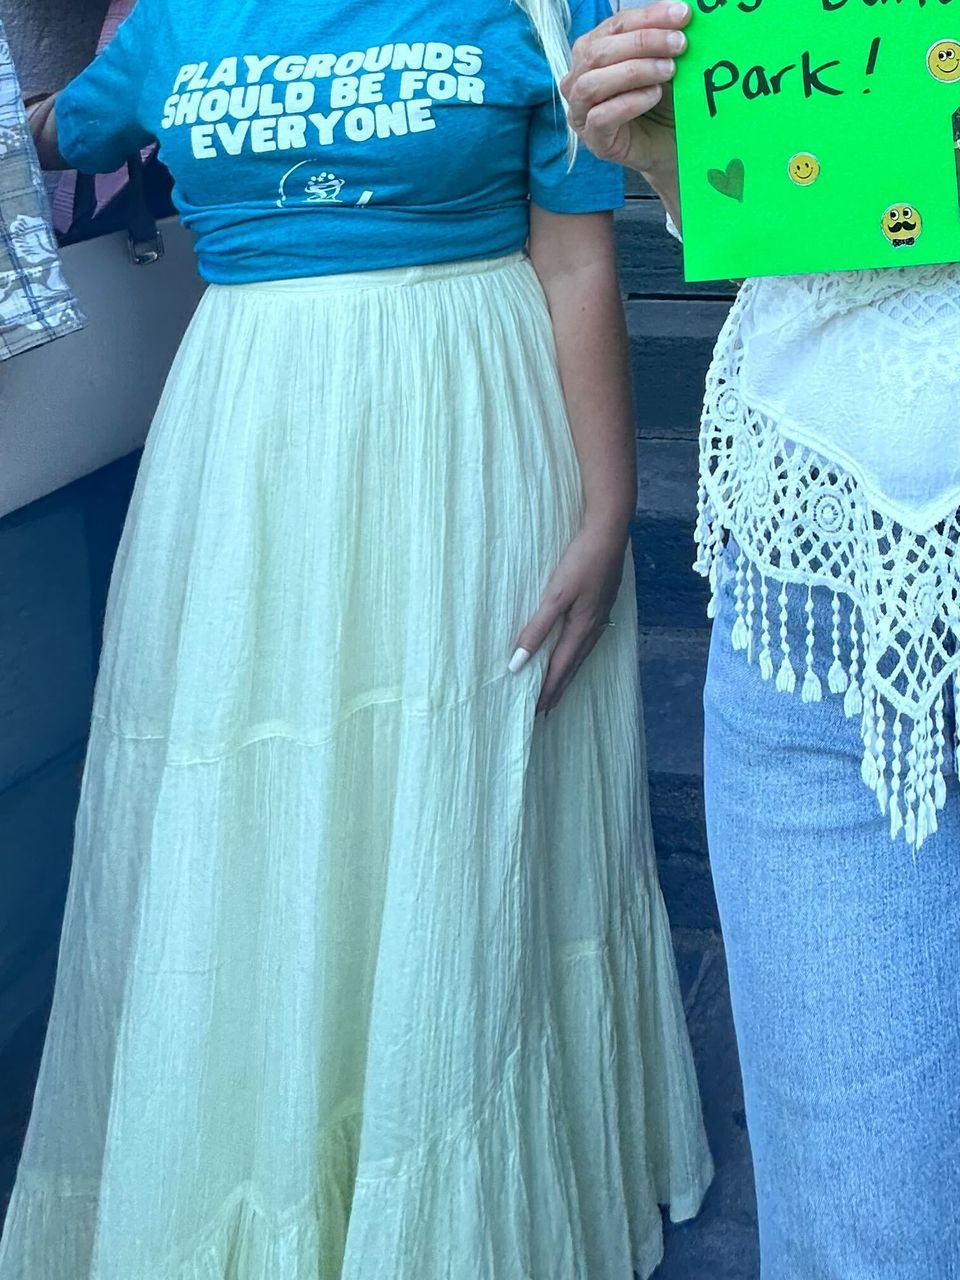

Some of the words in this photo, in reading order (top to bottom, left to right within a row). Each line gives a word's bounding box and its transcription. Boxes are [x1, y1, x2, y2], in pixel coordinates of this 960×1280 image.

[172, 42, 484, 94] PLAYGROUNDS
[161, 81, 315, 129] SHOULD
[330, 73, 385, 108] BE
[399, 71, 485, 104] FOR
[190, 99, 436, 159] EVERYONE
